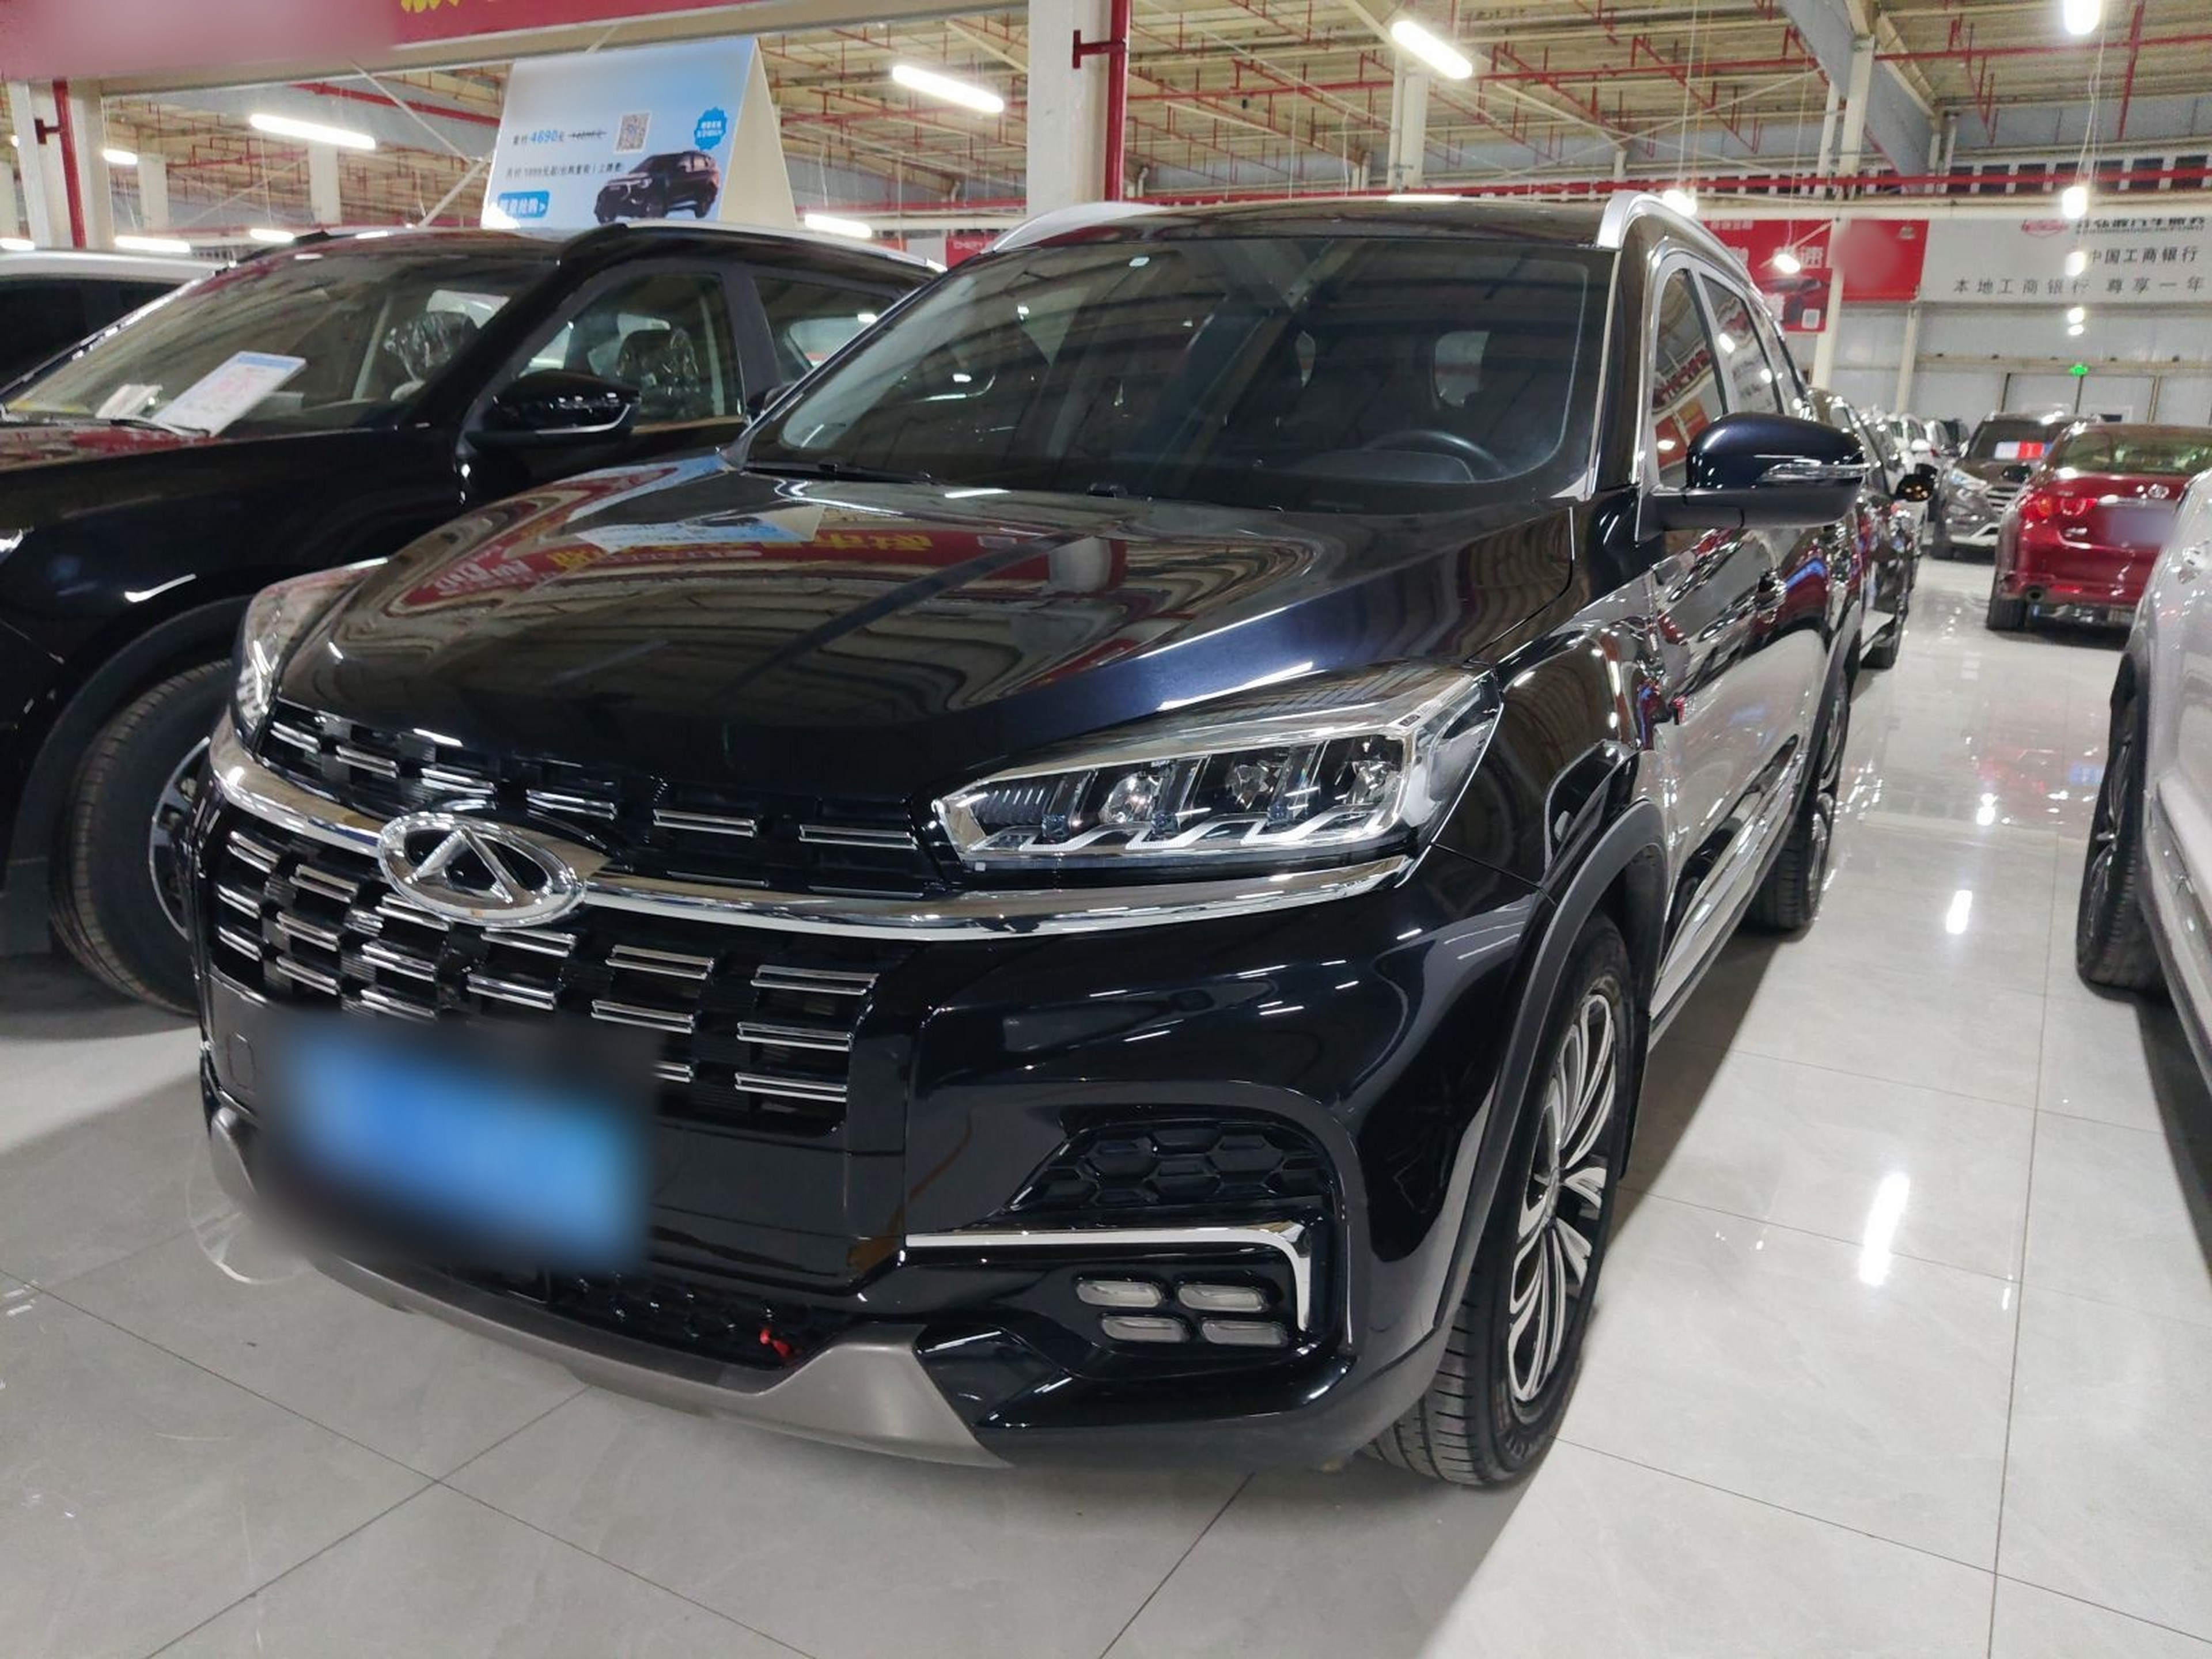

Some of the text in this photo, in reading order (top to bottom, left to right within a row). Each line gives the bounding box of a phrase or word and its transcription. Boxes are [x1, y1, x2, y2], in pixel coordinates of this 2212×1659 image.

[2090, 246, 2199, 264] 中国工商银行
[1953, 276, 2090, 294] 本地工商银行
